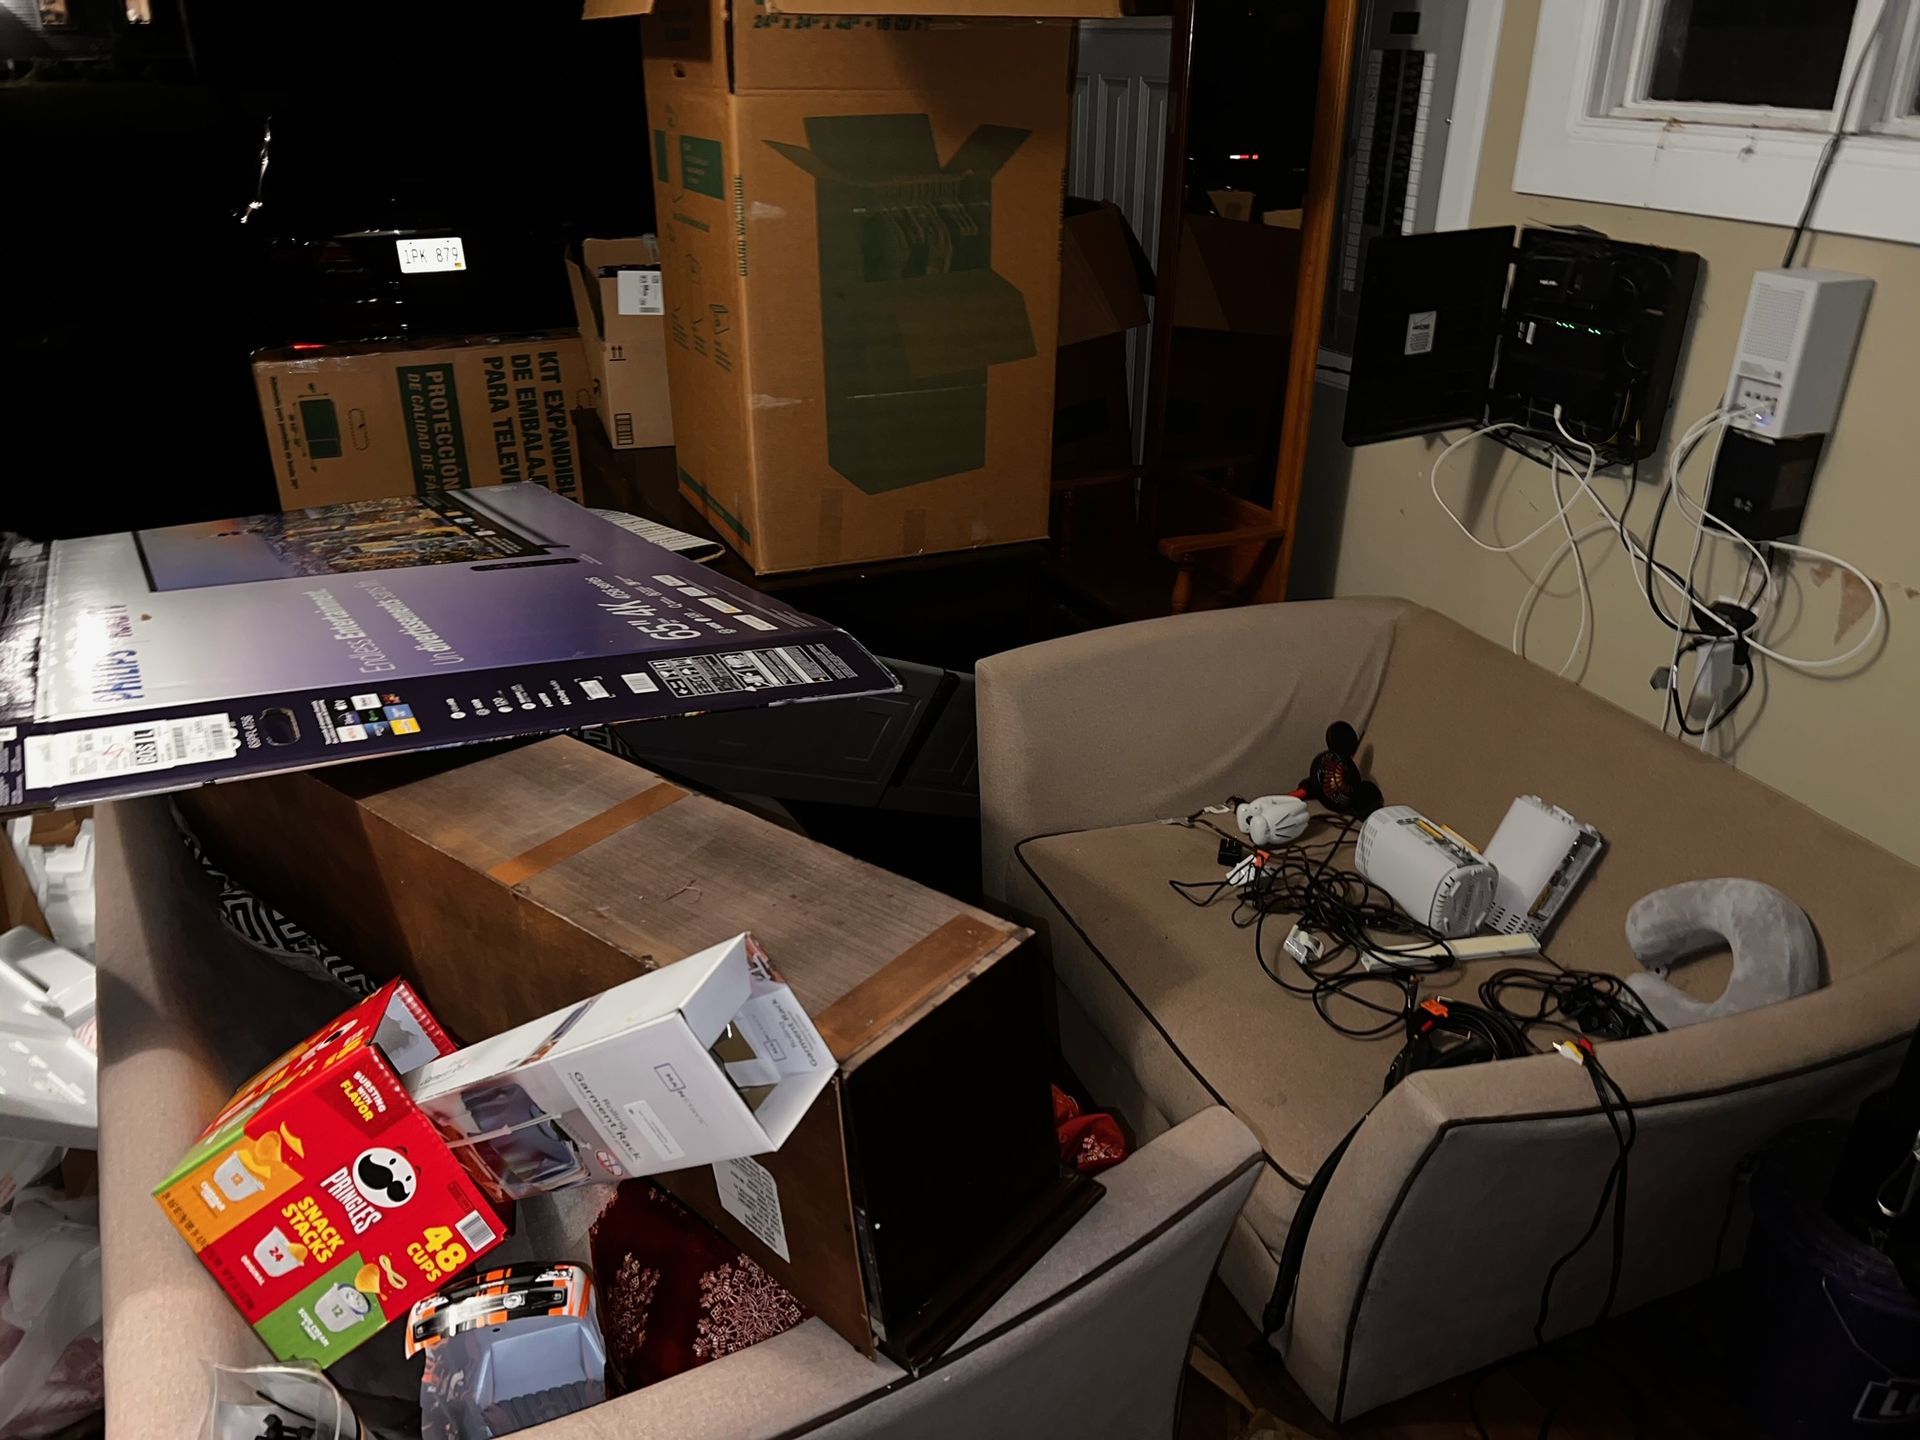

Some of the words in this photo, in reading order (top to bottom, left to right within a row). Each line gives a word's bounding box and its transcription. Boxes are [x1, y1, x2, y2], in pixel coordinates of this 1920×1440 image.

[435, 246, 459, 263] 879
[406, 372, 424, 391] DE
[482, 356, 510, 413] PARA
[510, 354, 533, 382] DE
[537, 351, 561, 383] KIT
[410, 394, 433, 450] CALIDAD
[424, 368, 463, 493] PROTECCIÓN
[419, 453, 435, 473] DE
[596, 599, 657, 616] 4K
[347, 640, 397, 673] Endless
[430, 651, 465, 666] Un
[771, 998, 790, 1024] Rack
[791, 1029, 819, 1068] Garment
[338, 1079, 375, 1123] FLAVOR
[351, 1070, 387, 1114] BURSTING
[356, 1086, 375, 1107] WITH
[574, 1071, 619, 1128] Garment
[616, 1130, 642, 1160] Rack
[602, 1098, 629, 1133] Rolling
[320, 1166, 382, 1235] PRINGLES
[281, 1203, 335, 1265] STACKS
[296, 1195, 345, 1251] SNACK
[268, 1246, 285, 1263] 24
[406, 1242, 442, 1283] CUPS
[421, 1224, 468, 1273] 48
[330, 1304, 344, 1319] 12
